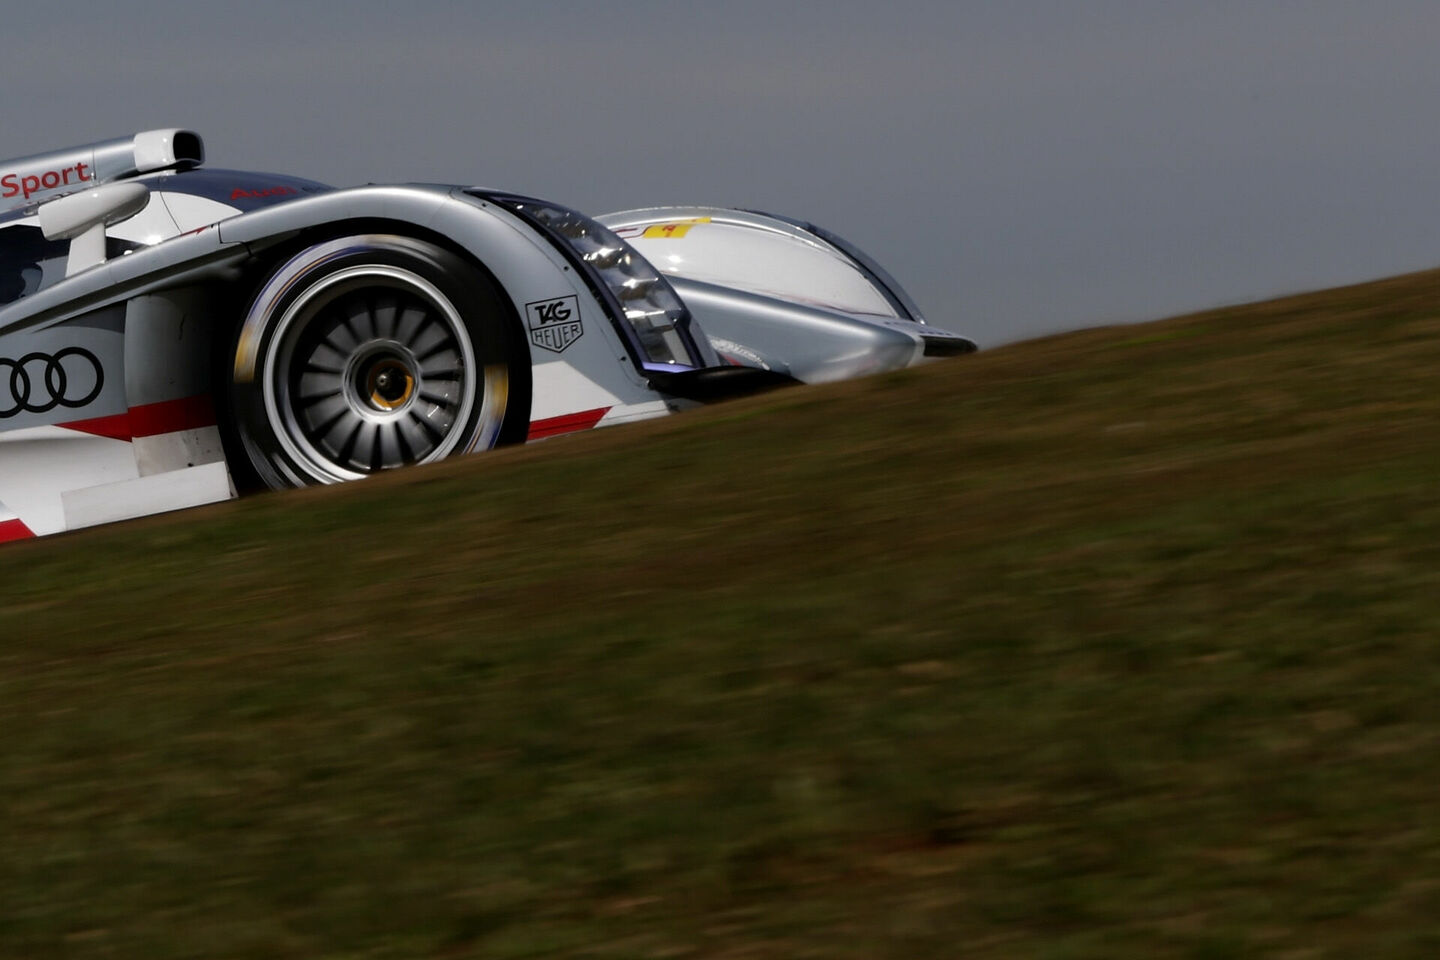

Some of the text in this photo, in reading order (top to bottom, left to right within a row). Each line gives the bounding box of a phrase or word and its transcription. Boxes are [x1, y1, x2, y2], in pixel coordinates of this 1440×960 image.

[1, 162, 90, 200] Sport
[534, 301, 571, 325] TAG
[534, 324, 580, 349] HEUER
